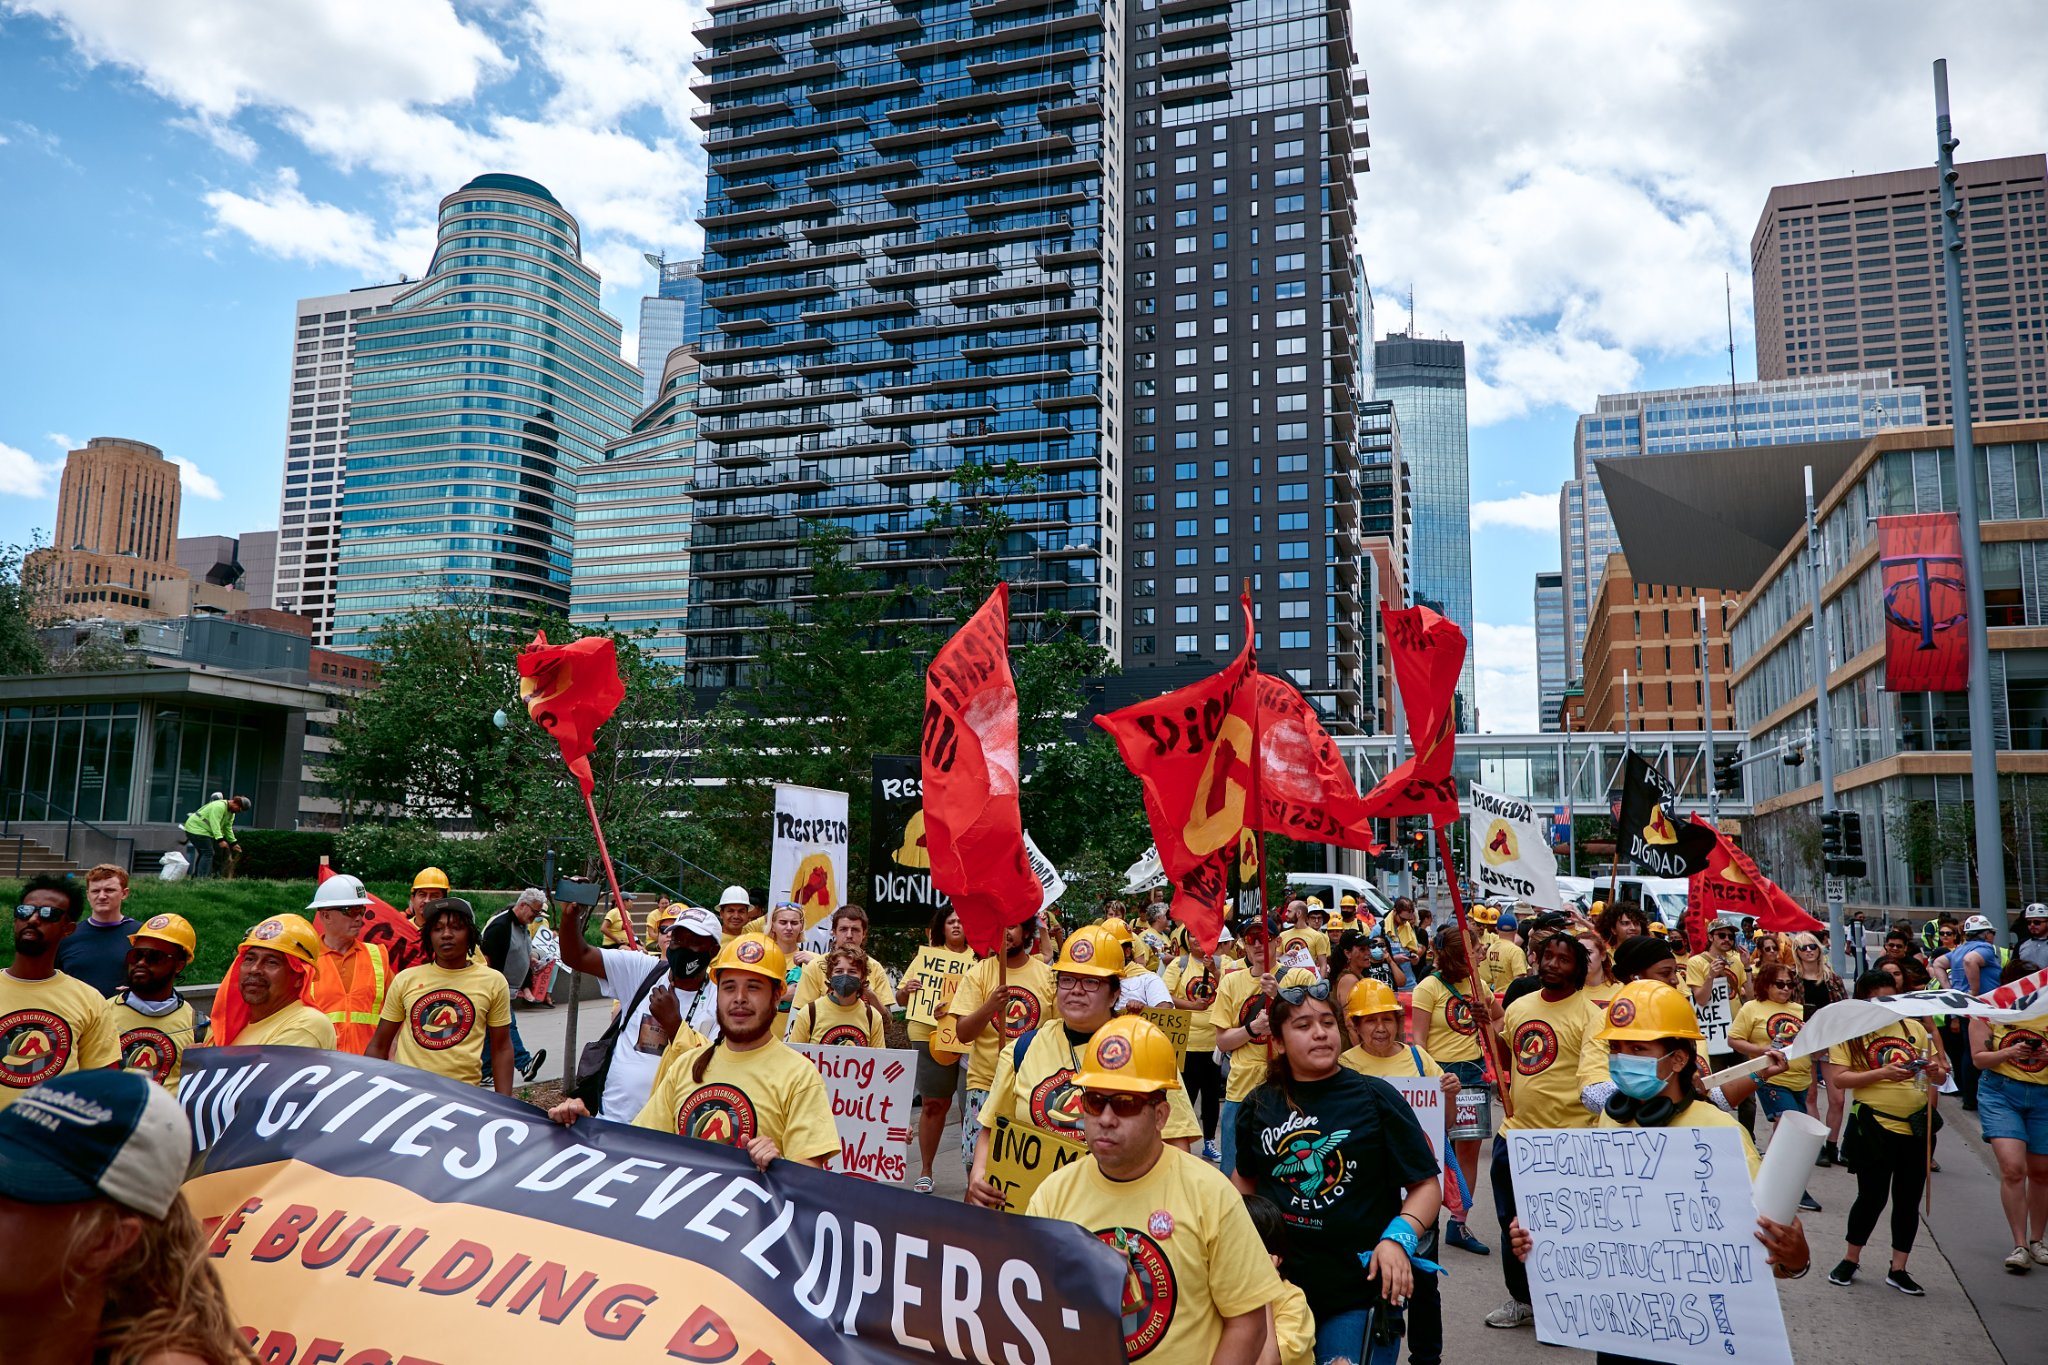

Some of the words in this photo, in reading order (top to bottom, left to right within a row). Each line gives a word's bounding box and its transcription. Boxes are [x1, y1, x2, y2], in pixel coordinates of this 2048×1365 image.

[776, 811, 848, 844] RESPETO
[923, 955, 945, 973] WE
[1283, 953, 1309, 968] RESPETO
[22, 1014, 54, 1025] DIGNIDAD
[1171, 1032, 1186, 1045] TO
[7, 1073, 31, 1084] DIGNITY
[32, 1073, 45, 1082] AND
[44, 1056, 63, 1076] RESPECT
[714, 1089, 740, 1104] DIGNIDAD
[831, 1088, 894, 1124] built
[255, 1064, 530, 1180] CITIES
[1260, 1110, 1319, 1156] Poden
[840, 1131, 907, 1181] Workers
[1514, 1131, 1667, 1180] DIGNITY
[1290, 1160, 1357, 1210] FELLOWS
[1525, 1185, 1643, 1235] RESPECT
[1665, 1191, 1725, 1232] FOR
[250, 1203, 659, 1342] BUILDING
[1147, 1257, 1168, 1298] RESPETO
[1535, 1239, 1753, 1284] CONSTRUCTION
[1137, 1311, 1164, 1346] RESPECT
[1544, 1292, 1736, 1356] WORKERS!
